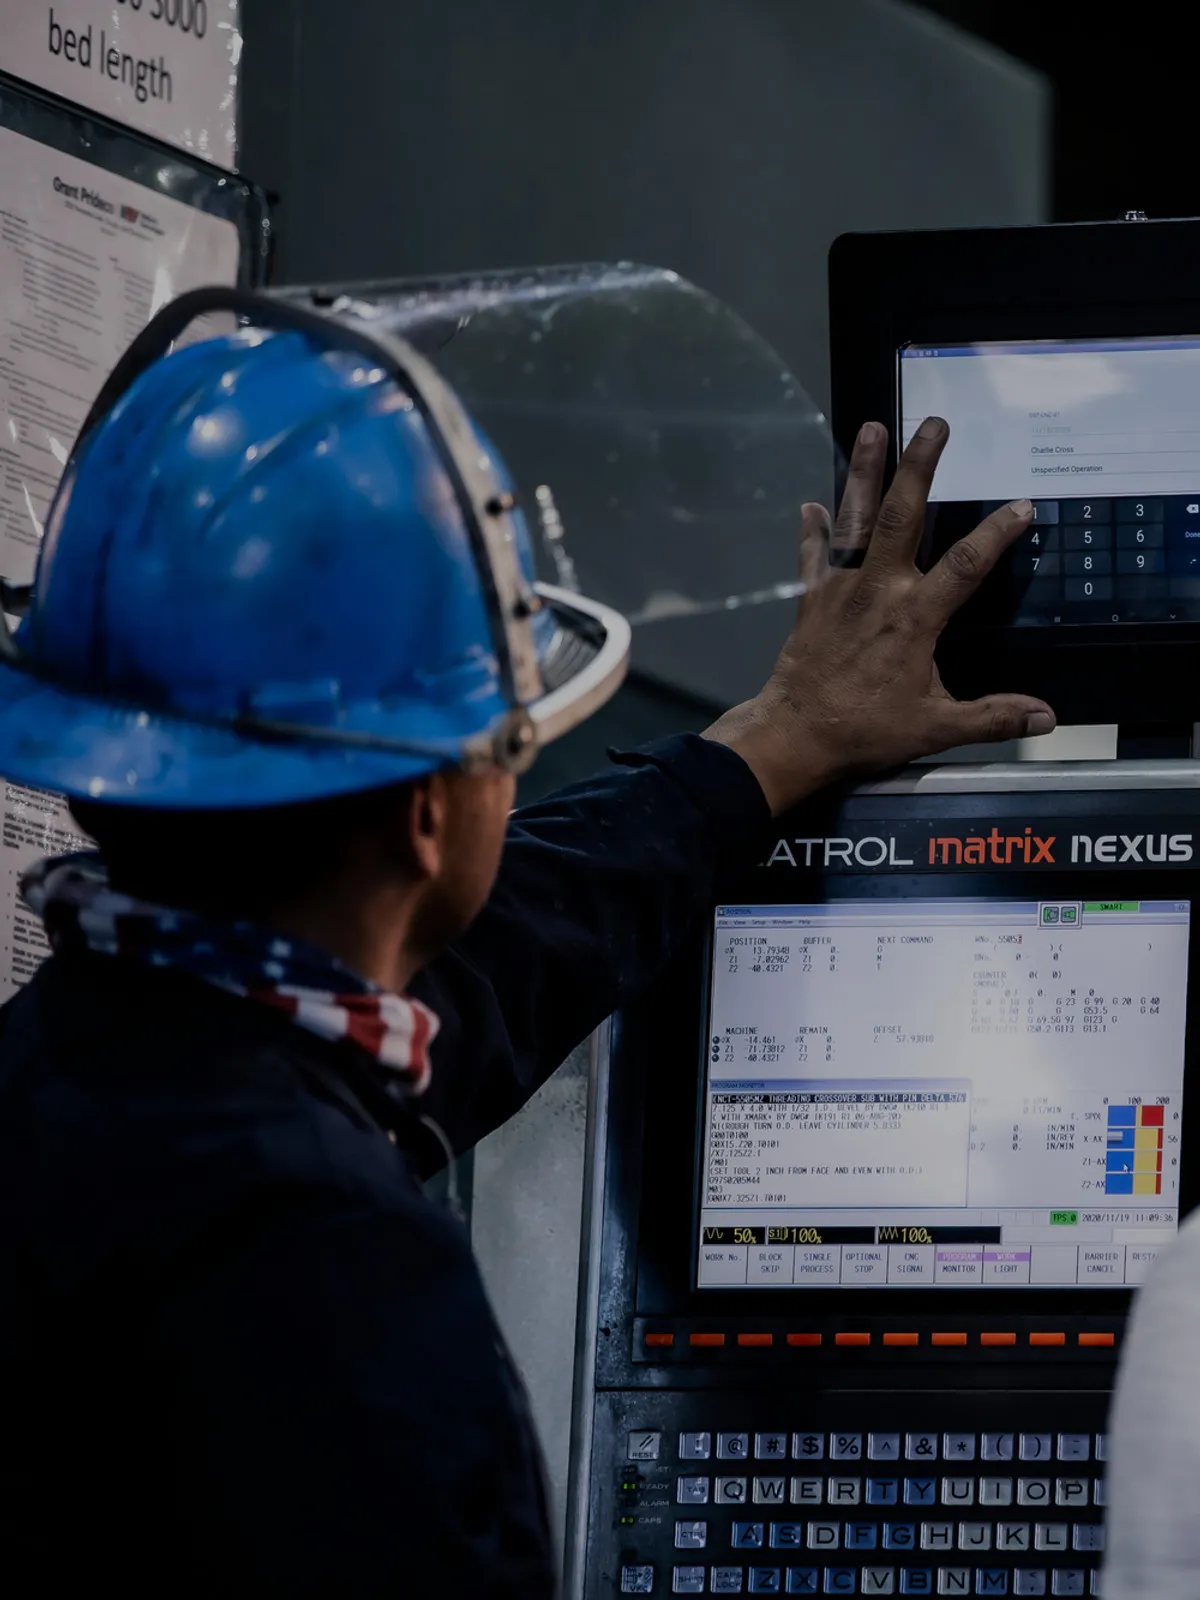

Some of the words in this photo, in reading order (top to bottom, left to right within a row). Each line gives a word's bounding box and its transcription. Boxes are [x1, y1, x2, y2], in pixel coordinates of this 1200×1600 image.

[48, 7, 92, 69] bed
[100, 29, 173, 103] length
[1031, 466, 1069, 474] Unspecified
[1071, 465, 1102, 473] Operation
[1083, 506, 1092, 518] 2
[1135, 504, 1144, 517] 3
[1031, 532, 1040, 545] 4
[1084, 531, 1092, 544] 5
[1136, 530, 1145, 543] 6
[1032, 558, 1041, 571] 7
[1084, 557, 1092, 569] 8
[1136, 555, 1145, 568] 9
[1084, 583, 1093, 595] 0
[756, 837, 914, 867] ATROL
[928, 827, 1055, 864] matrix
[1100, 903, 1122, 911] SMART
[729, 937, 767, 945] POSITION
[877, 936, 896, 944] NEXT
[900, 936, 934, 944] COMMAND
[725, 1027, 758, 1035] MACHINE
[799, 1026, 829, 1034] REMAIN
[769, 1094, 810, 1103] THREADING
[815, 1094, 858, 1102] CROSSOVER
[880, 1094, 898, 1102] WITH
[903, 1094, 917, 1102] PIN
[921, 1094, 944, 1102] DELTA
[792, 1104, 810, 1112] 1/32
[721, 1113, 741, 1121] WITH
[777, 1113, 787, 1121] BY
[754, 1122, 773, 1130] TURN
[799, 1122, 822, 1130] LEAVE
[733, 1167, 751, 1175] TOOL
[766, 1167, 785, 1175] INCH
[788, 1167, 808, 1175] FROM
[811, 1167, 830, 1175] FACE
[1082, 1213, 1130, 1222] 2020/11/19
[1136, 1213, 1174, 1222] 11:09:36
[733, 1228, 757, 1244] 50%
[791, 1228, 822, 1244] 100%
[900, 1227, 932, 1244] 100%
[705, 1253, 724, 1261] WORK
[759, 1253, 783, 1261] BLOCK
[803, 1253, 832, 1261] SINGLE
[846, 1253, 883, 1261] OPTIONAL
[904, 1253, 919, 1261] CNC
[1084, 1253, 1119, 1261] BARRIER
[803, 1437, 818, 1455] $
[838, 1437, 858, 1455] %
[915, 1437, 933, 1455] &
[723, 1481, 743, 1499] Q
[760, 1482, 781, 1498] W
[801, 1482, 816, 1498] E
[838, 1483, 854, 1499] R
[876, 1483, 893, 1499] T
[914, 1483, 931, 1499] Y
[951, 1483, 969, 1499] U
[995, 1483, 1000, 1499] I
[1026, 1483, 1046, 1499] O
[1065, 1483, 1083, 1500] P
[639, 1500, 670, 1508] ALARM
[638, 1516, 662, 1525] CAPS
[741, 1528, 760, 1543] A
[779, 1527, 796, 1543] S
[817, 1527, 835, 1543] D
[855, 1528, 872, 1544] F
[892, 1527, 911, 1544] G
[931, 1528, 948, 1544] H
[970, 1528, 985, 1544] J
[1006, 1528, 1024, 1544] K
[1046, 1528, 1061, 1545] L
[759, 1572, 776, 1588] Z
[796, 1572, 812, 1588] X
[833, 1572, 851, 1588] C
[871, 1573, 889, 1589] V
[909, 1573, 927, 1588] B
[947, 1573, 964, 1588] N
[984, 1574, 1005, 1589] M
